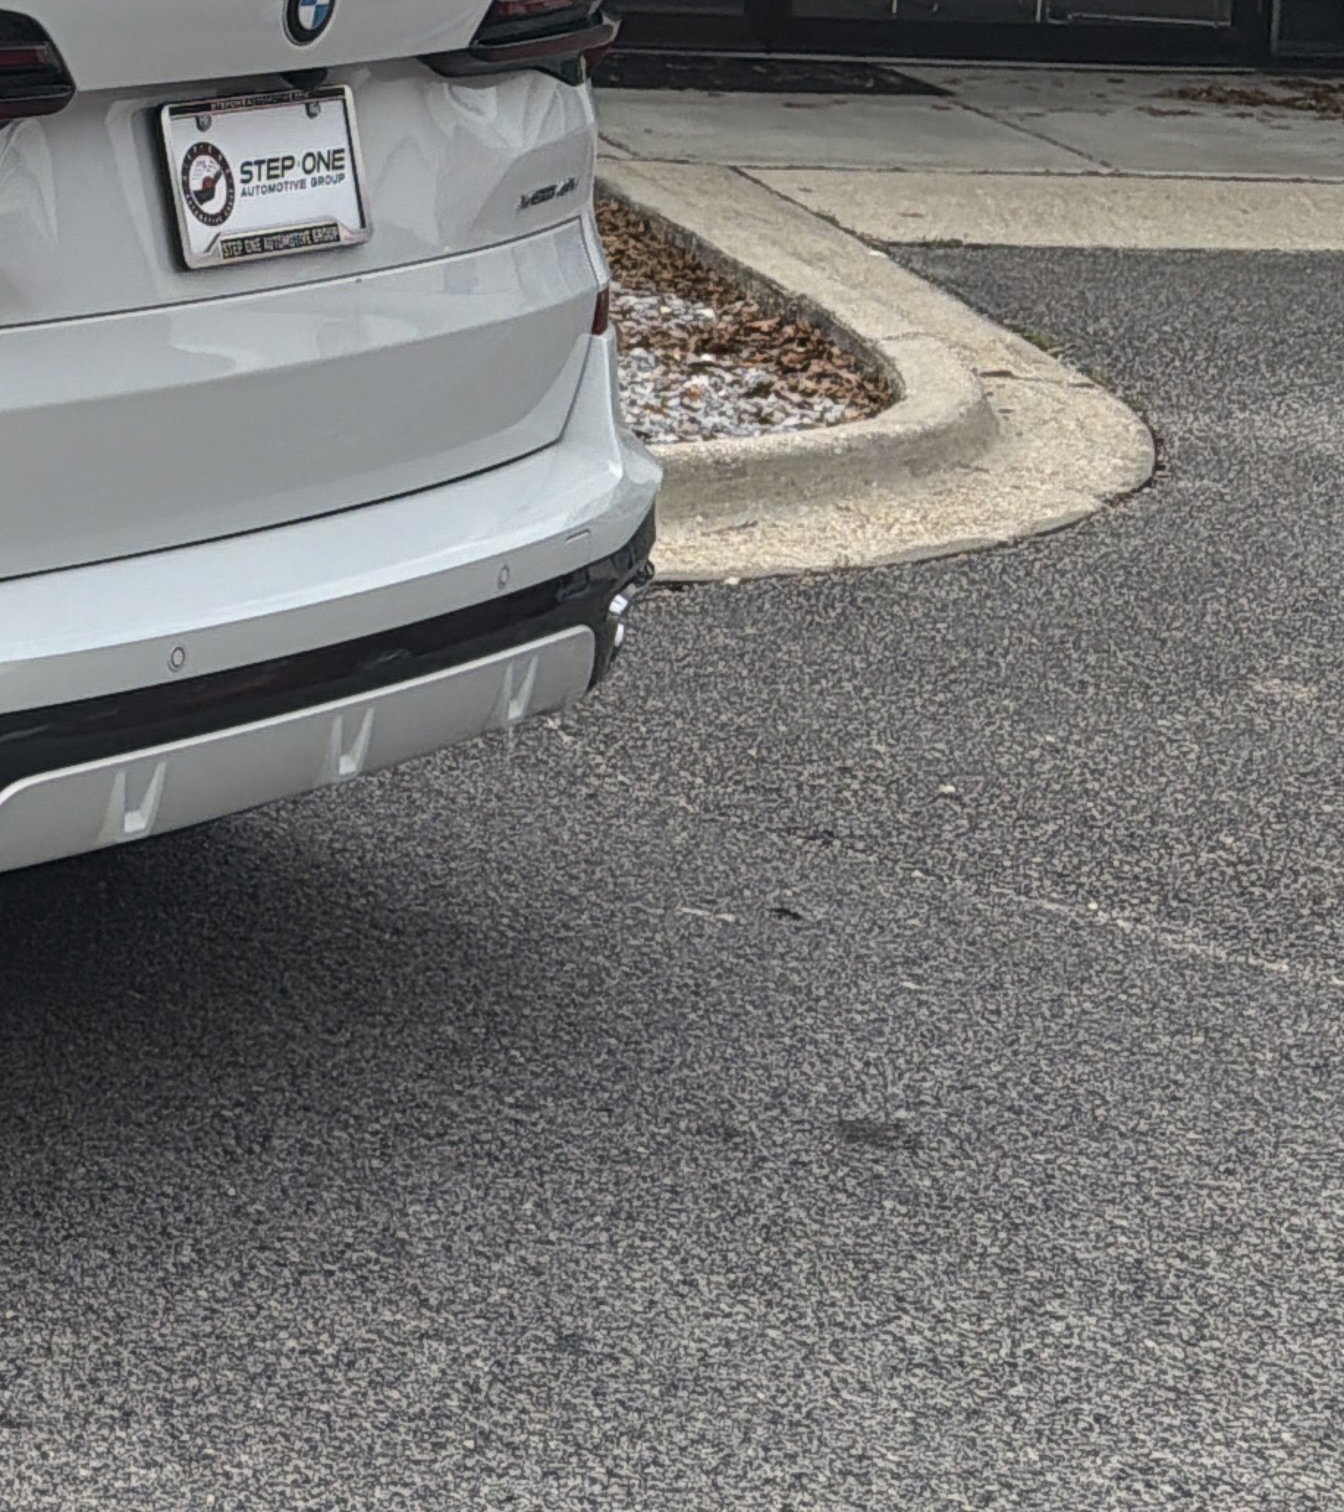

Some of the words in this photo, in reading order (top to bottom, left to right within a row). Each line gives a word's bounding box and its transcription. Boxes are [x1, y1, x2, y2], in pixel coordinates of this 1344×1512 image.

[239, 155, 296, 184] STEP
[301, 148, 346, 175] ONE
[240, 178, 307, 199] AUTOMOTIVE
[310, 173, 346, 189] GROUP
[222, 239, 243, 258] STEP
[244, 237, 262, 252] ONE
[263, 231, 311, 250] AUTOMOTIVE
[312, 226, 339, 243] GROUP
